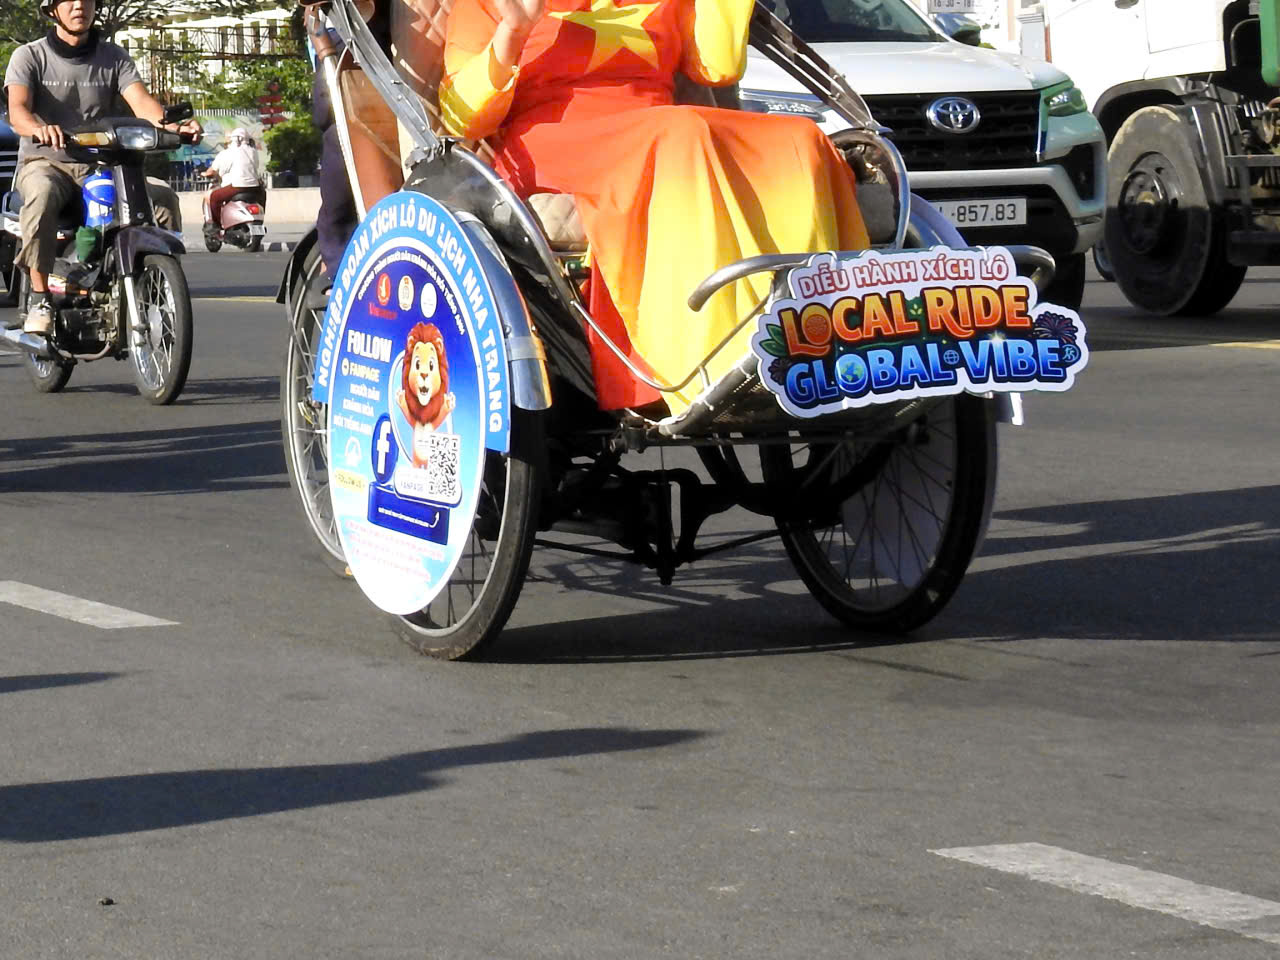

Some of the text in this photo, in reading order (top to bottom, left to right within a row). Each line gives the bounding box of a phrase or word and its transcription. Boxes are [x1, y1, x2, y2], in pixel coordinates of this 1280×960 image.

[799, 254, 1010, 299] DIỄU HÀNH XÍCH LÔ
[318, 197, 503, 434] NGHIỆP ĐOÀN XÍCH LÔ DU LỊCH NHA TRANG
[778, 285, 1032, 357] LOCAL RIDE
[346, 329, 393, 363] FOLLOW
[349, 362, 380, 383] FANPAGE
[784, 336, 1066, 406] GLOBAL VIBE
